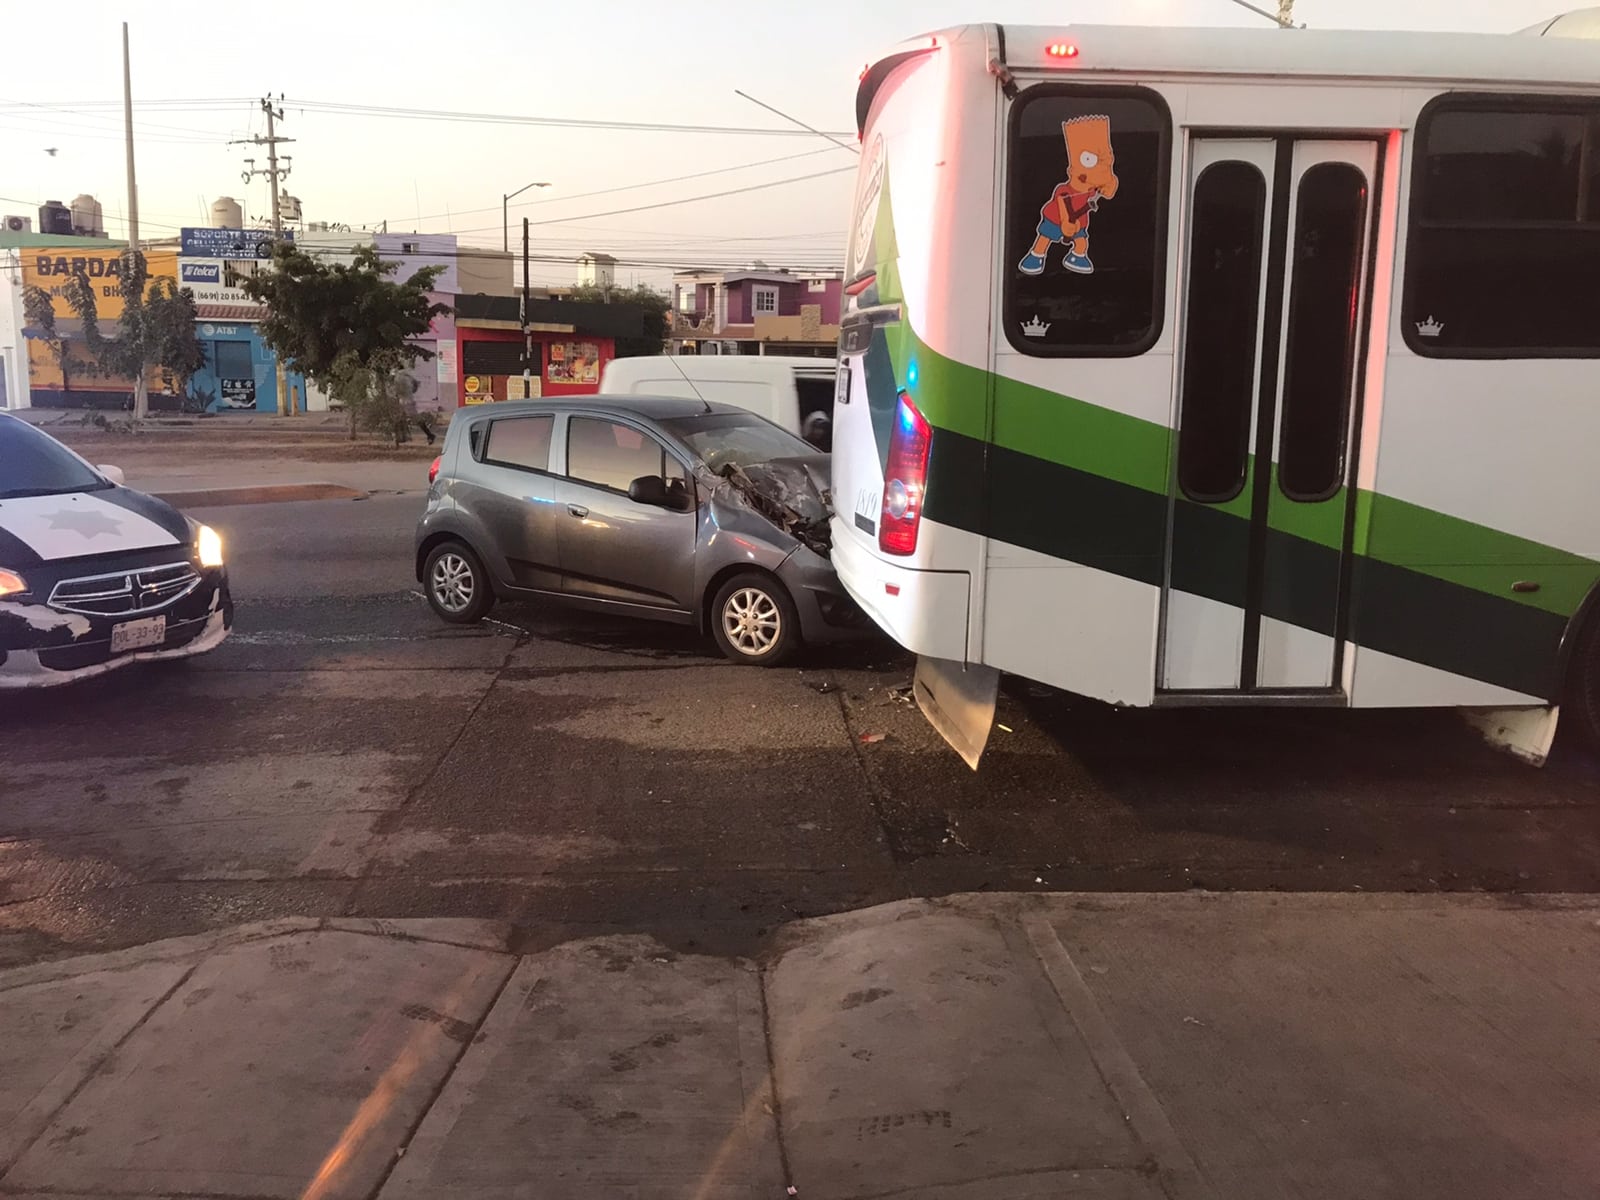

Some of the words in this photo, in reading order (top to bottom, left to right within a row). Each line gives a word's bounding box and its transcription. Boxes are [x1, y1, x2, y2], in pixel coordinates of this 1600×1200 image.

[193, 230, 241, 239] SOPORTE
[37, 256, 153, 278] BARDA
[193, 266, 217, 277] telcel
[221, 292, 230, 300] 20
[216, 327, 237, 335] AT&T
